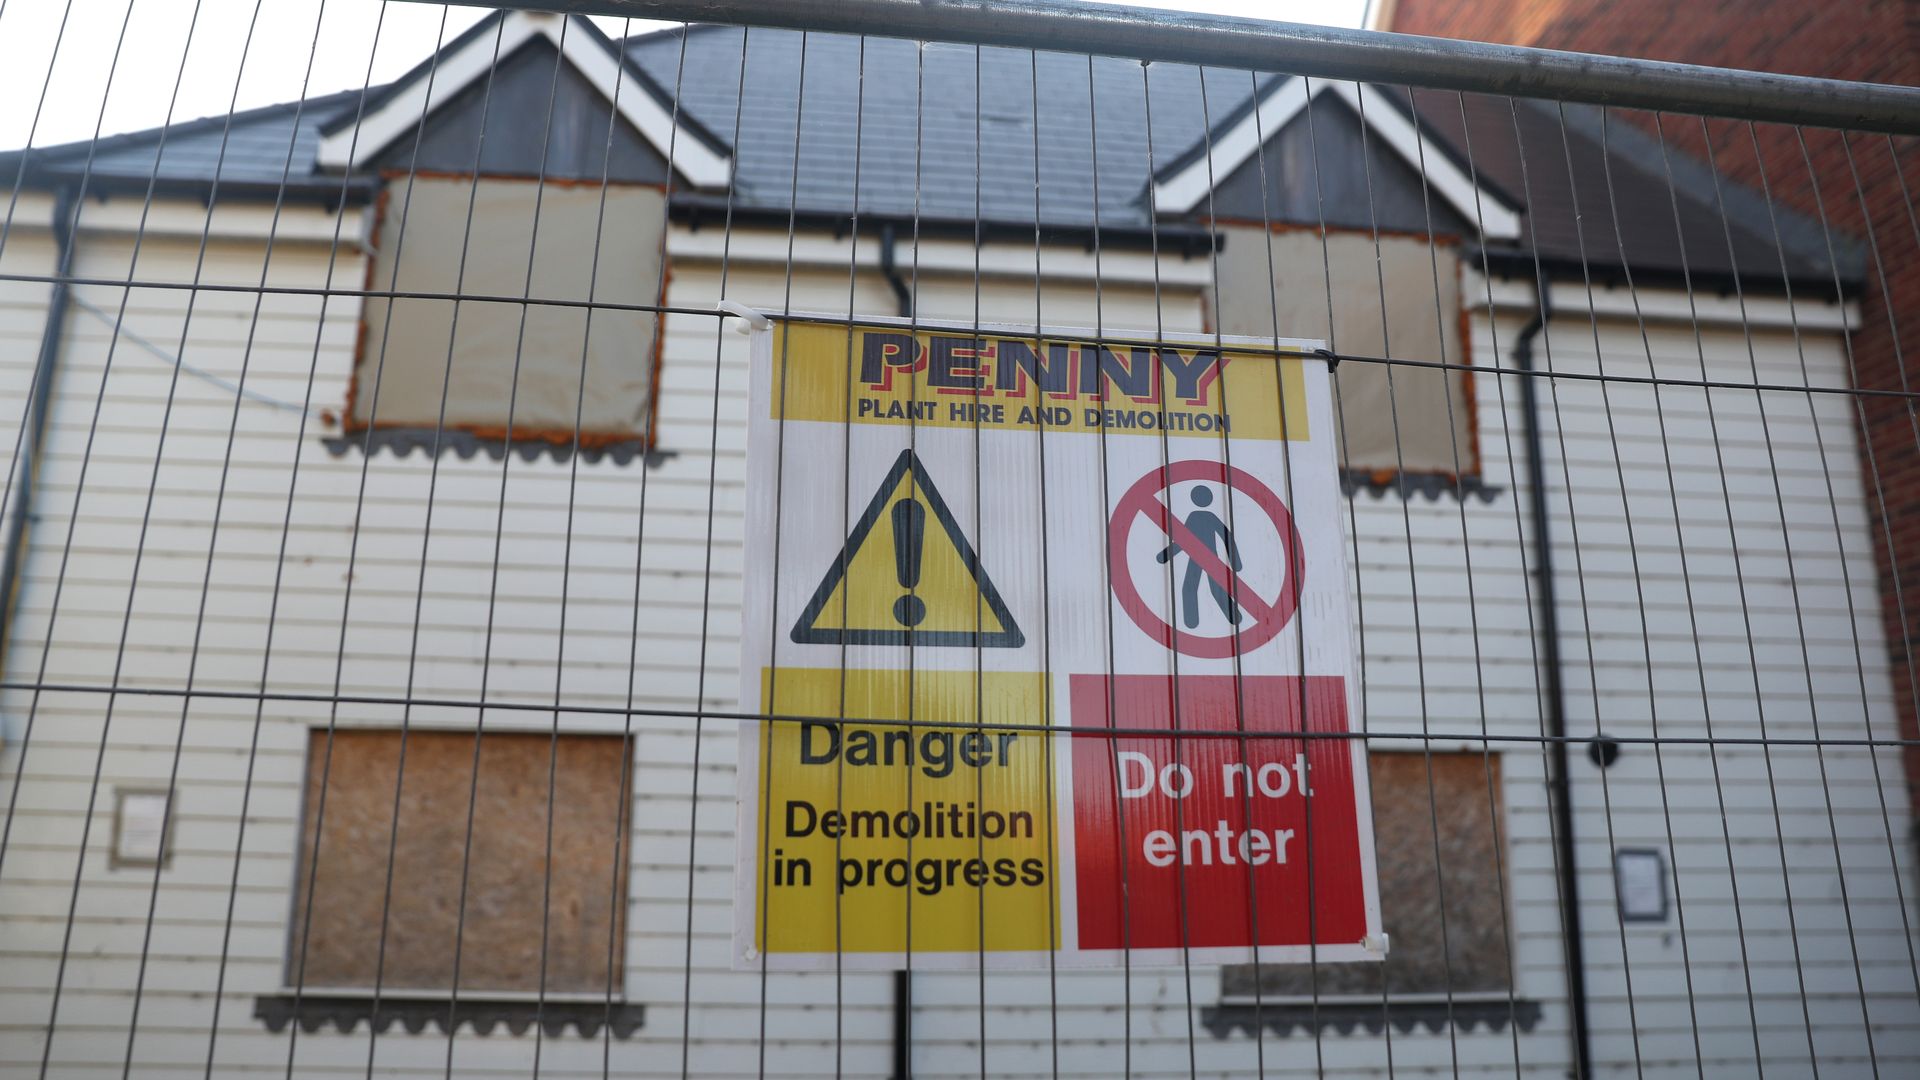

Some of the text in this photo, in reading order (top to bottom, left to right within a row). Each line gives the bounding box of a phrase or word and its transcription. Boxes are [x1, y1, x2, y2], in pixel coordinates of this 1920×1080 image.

[859, 331, 1231, 406] PENNY
[858, 398, 1231, 433] PLANT HIRE AND DEMOLITION
[800, 721, 1018, 778] Danger
[1117, 751, 1314, 799] Do not
[786, 801, 1033, 839] Demolition
[1142, 819, 1295, 867] enter
[773, 849, 1045, 895] in progress
